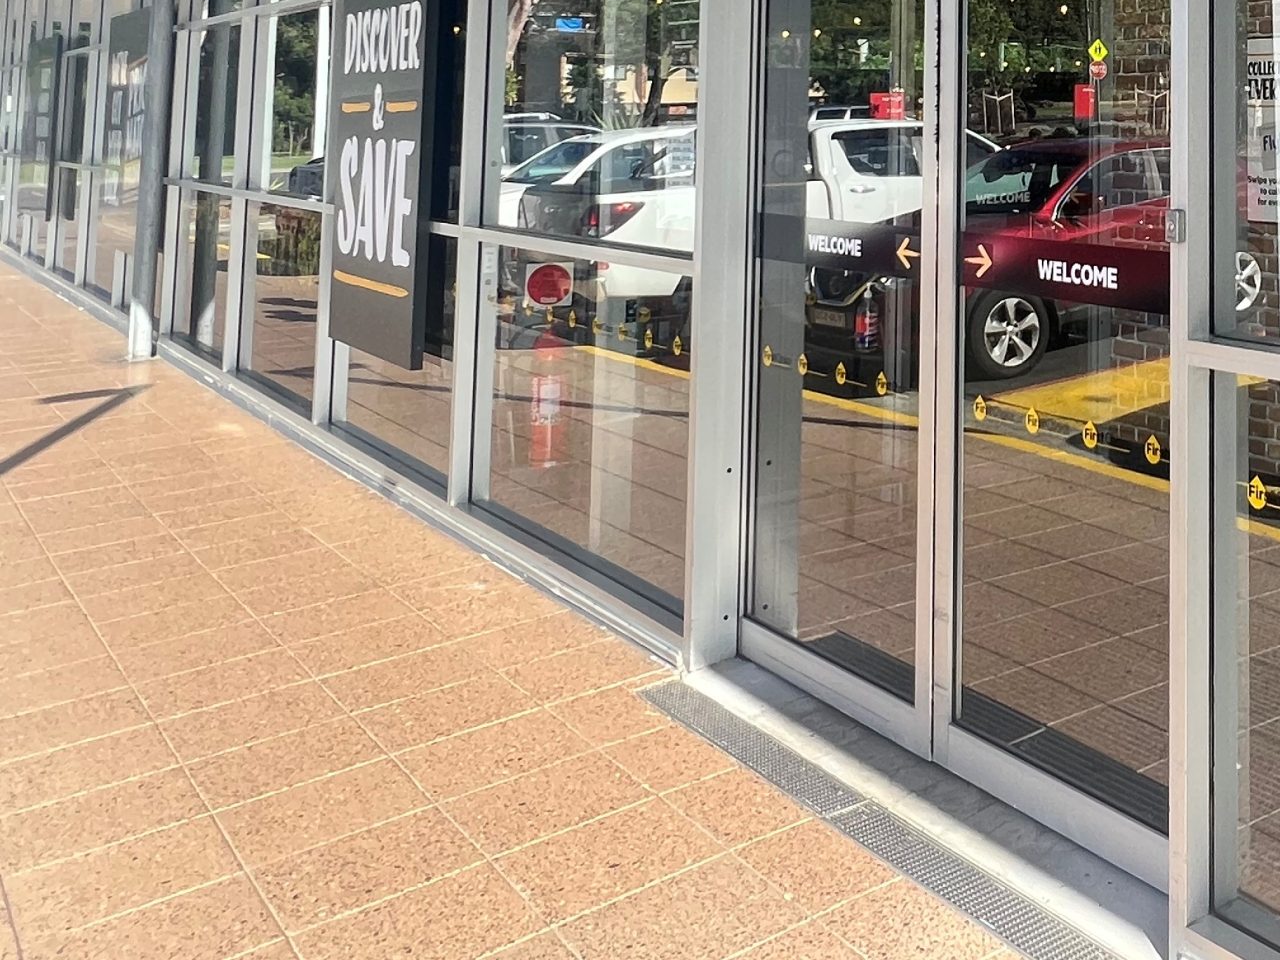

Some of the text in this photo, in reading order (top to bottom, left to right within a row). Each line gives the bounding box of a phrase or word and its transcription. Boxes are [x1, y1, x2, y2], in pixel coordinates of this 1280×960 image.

[344, 0, 421, 74] DISCOVER
[1248, 61, 1279, 75] COLLEC
[372, 82, 385, 131] &
[337, 137, 416, 267] SAVE
[976, 192, 1031, 205] WELCOME
[808, 234, 862, 257] WELCOME
[1037, 258, 1118, 290] WELCOME
